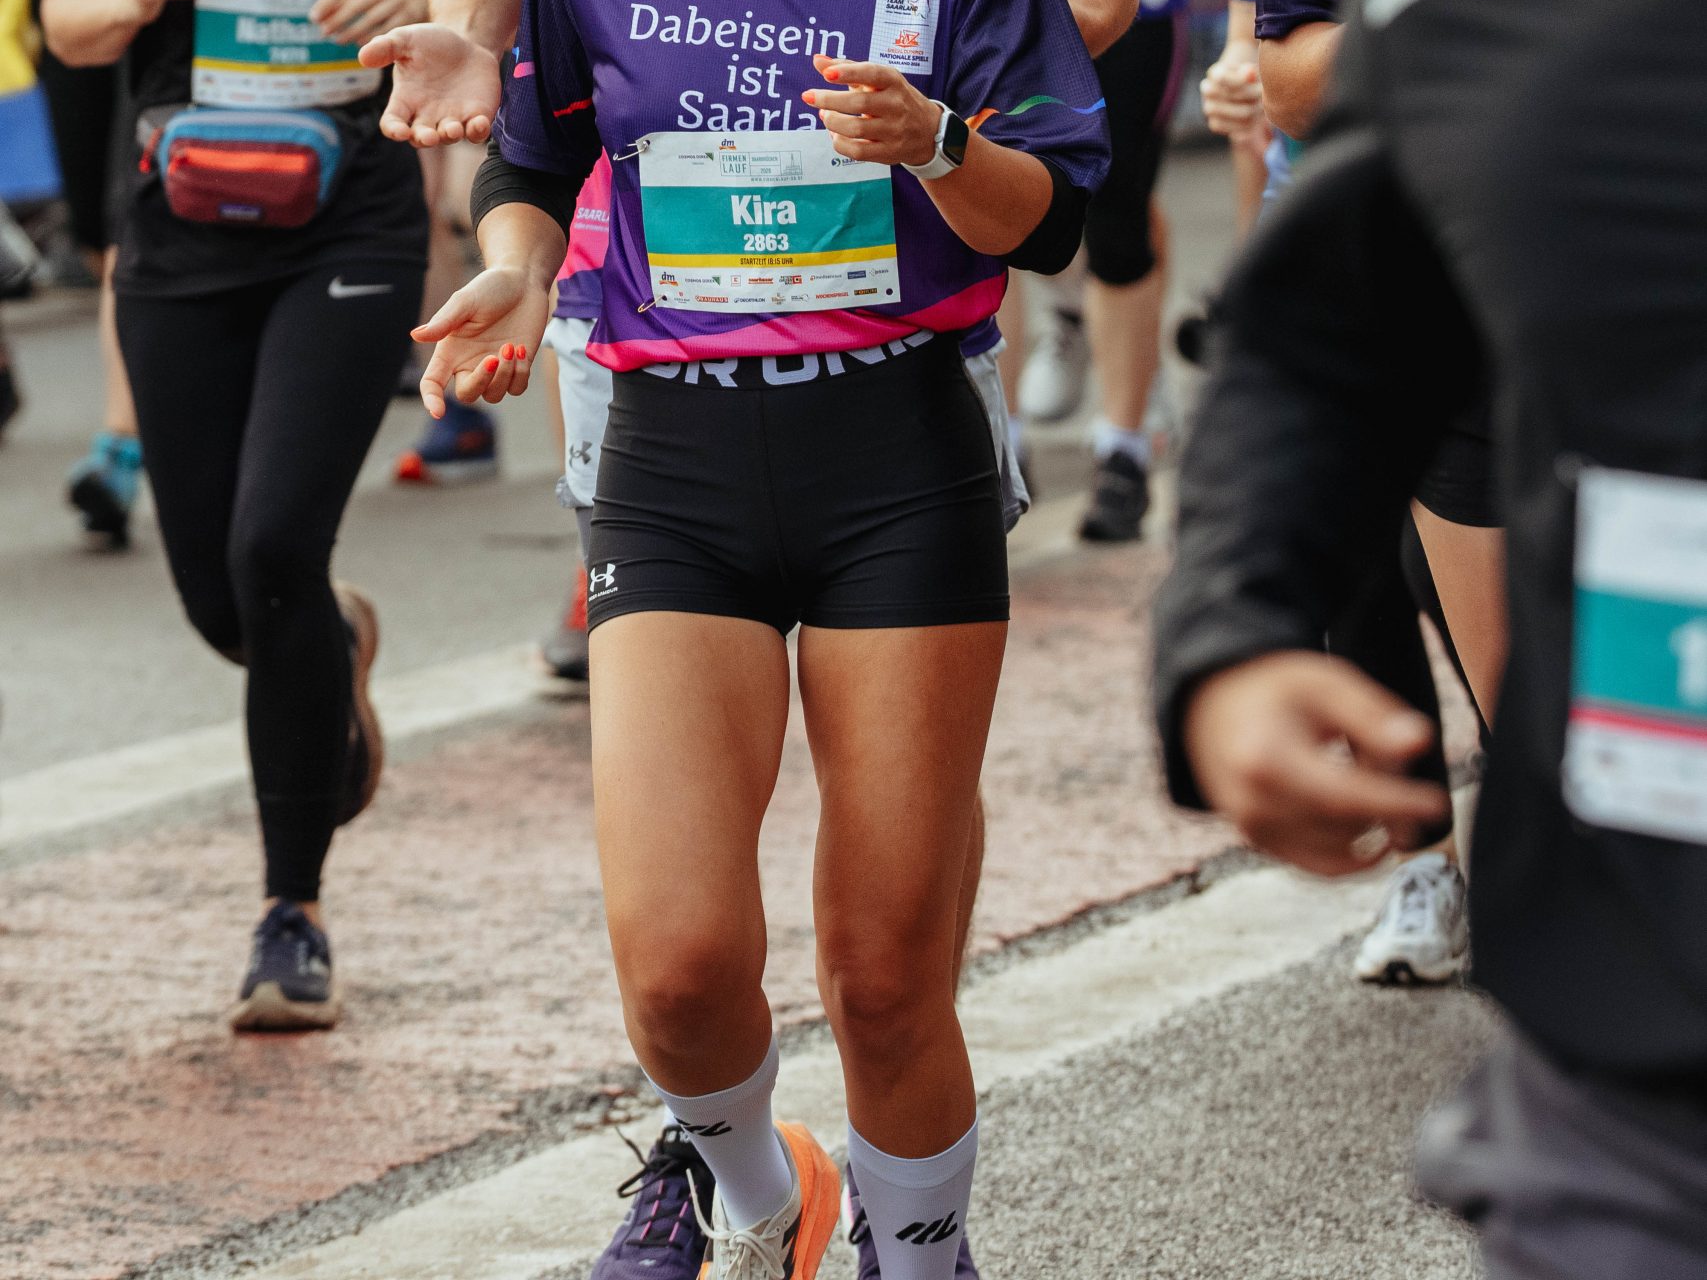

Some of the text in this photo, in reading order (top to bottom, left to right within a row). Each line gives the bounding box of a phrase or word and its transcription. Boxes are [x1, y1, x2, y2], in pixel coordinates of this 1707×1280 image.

[886, 3, 918, 11] SAARLAND
[629, 3, 847, 59] Dabeisein
[727, 53, 783, 98] ist
[721, 154, 747, 162] FIRMEN
[722, 163, 747, 174] LAUF
[731, 195, 797, 225] Kira
[743, 233, 789, 251] 2863
[740, 257, 766, 265] STARTZEIT
[661, 271, 675, 281] dm
